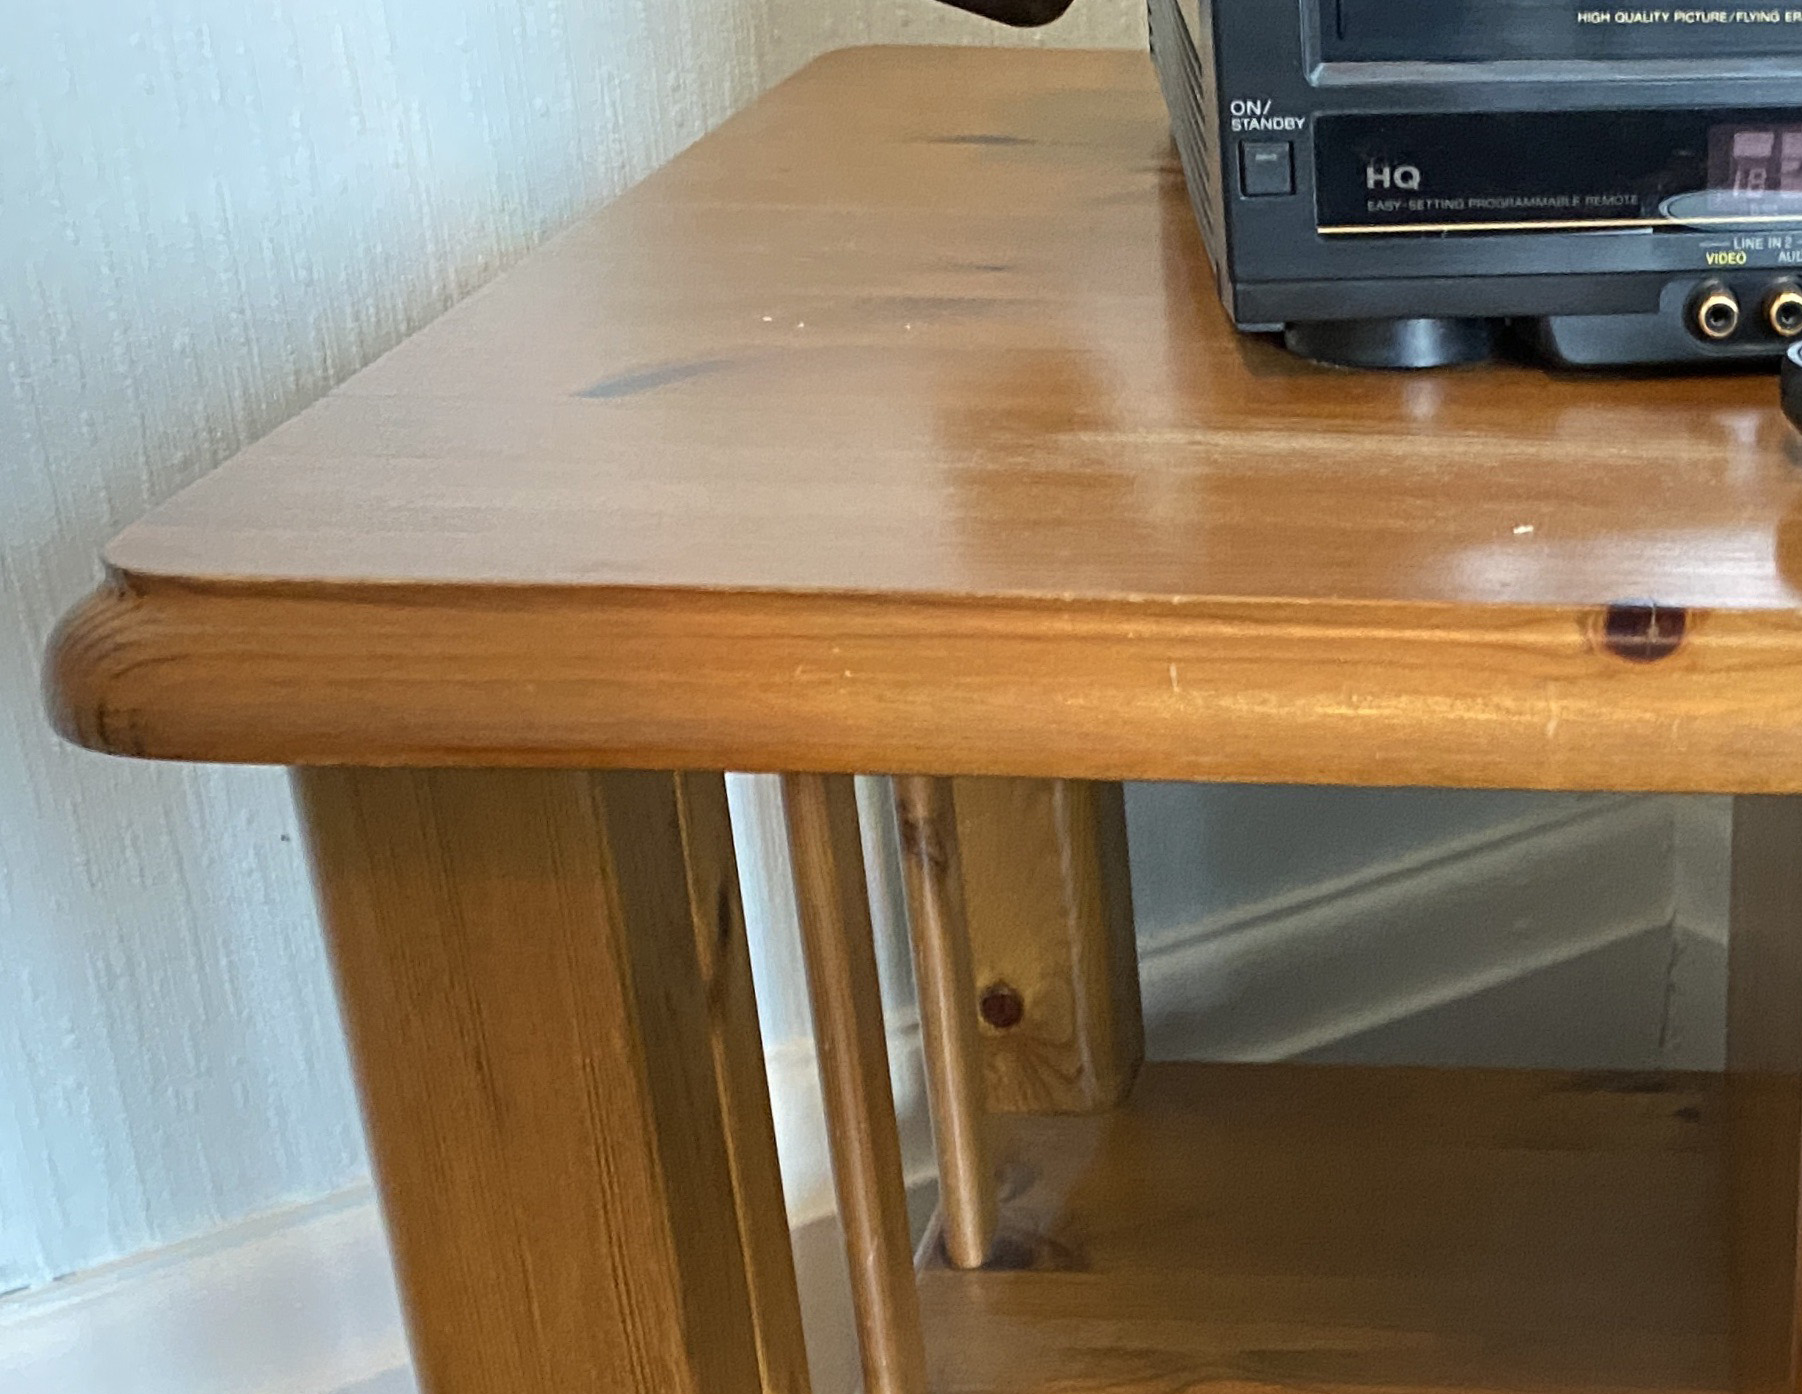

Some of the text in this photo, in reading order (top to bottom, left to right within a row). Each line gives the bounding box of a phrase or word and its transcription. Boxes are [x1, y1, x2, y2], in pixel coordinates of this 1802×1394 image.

[1577, 11, 1610, 24] HIGH
[1614, 11, 1670, 24] QUALITY
[1673, 11, 1780, 24] PICTURE/FLYING
[1229, 98, 1272, 117] ON/
[1230, 116, 1307, 132] STANDBY
[1366, 165, 1421, 190] HQ
[1468, 196, 1580, 209] PROGRAMMABLE
[1585, 194, 1639, 206] REMOTE
[1733, 235, 1793, 250] LINE IN 2
[1706, 250, 1748, 265] VIDEO
